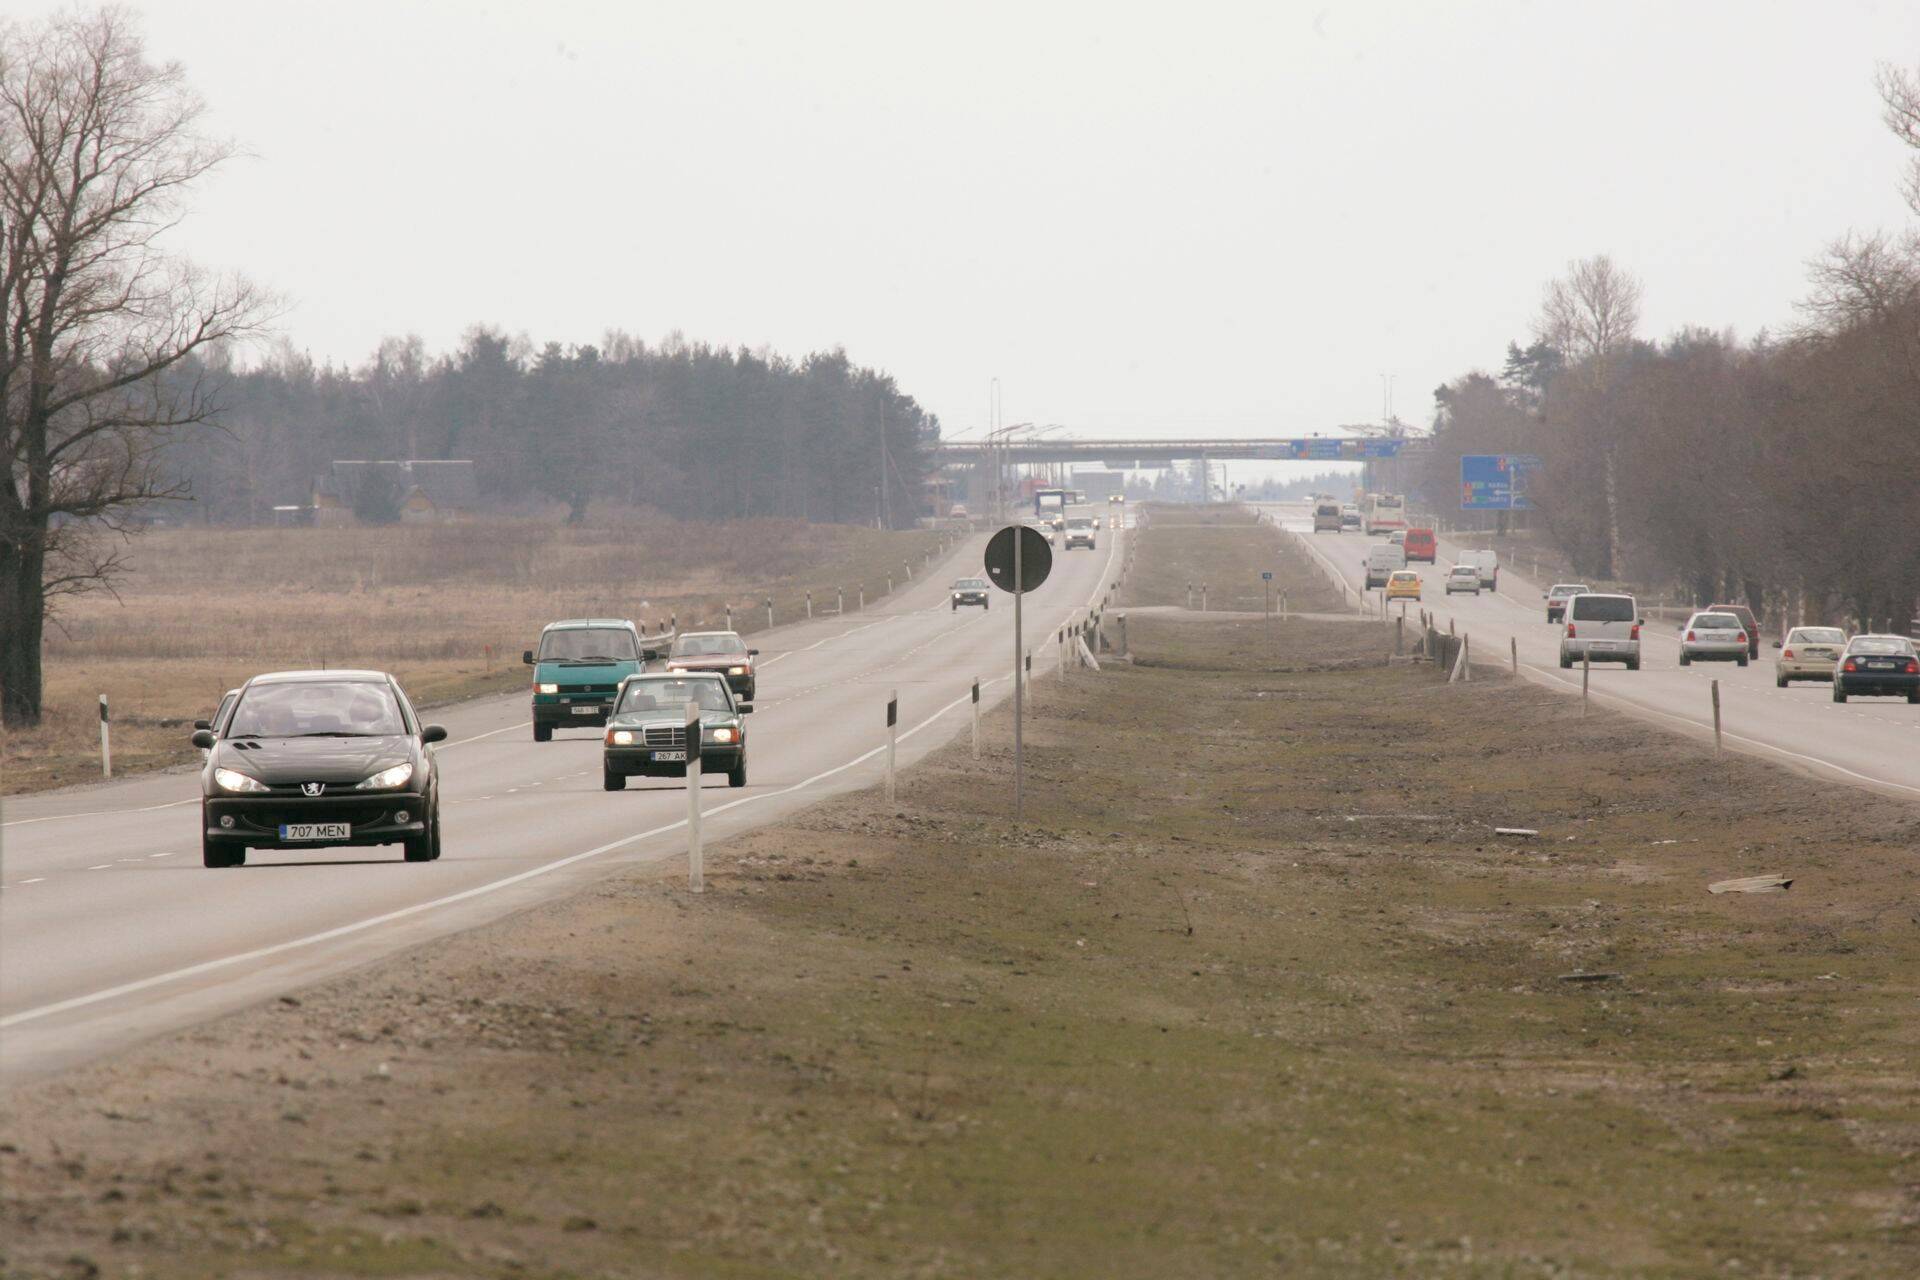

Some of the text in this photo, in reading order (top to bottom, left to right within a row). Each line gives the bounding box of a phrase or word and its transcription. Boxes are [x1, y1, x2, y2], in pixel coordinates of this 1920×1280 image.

[658, 752, 688, 760] 267 AK
[291, 825, 345, 837] 707 MEN
